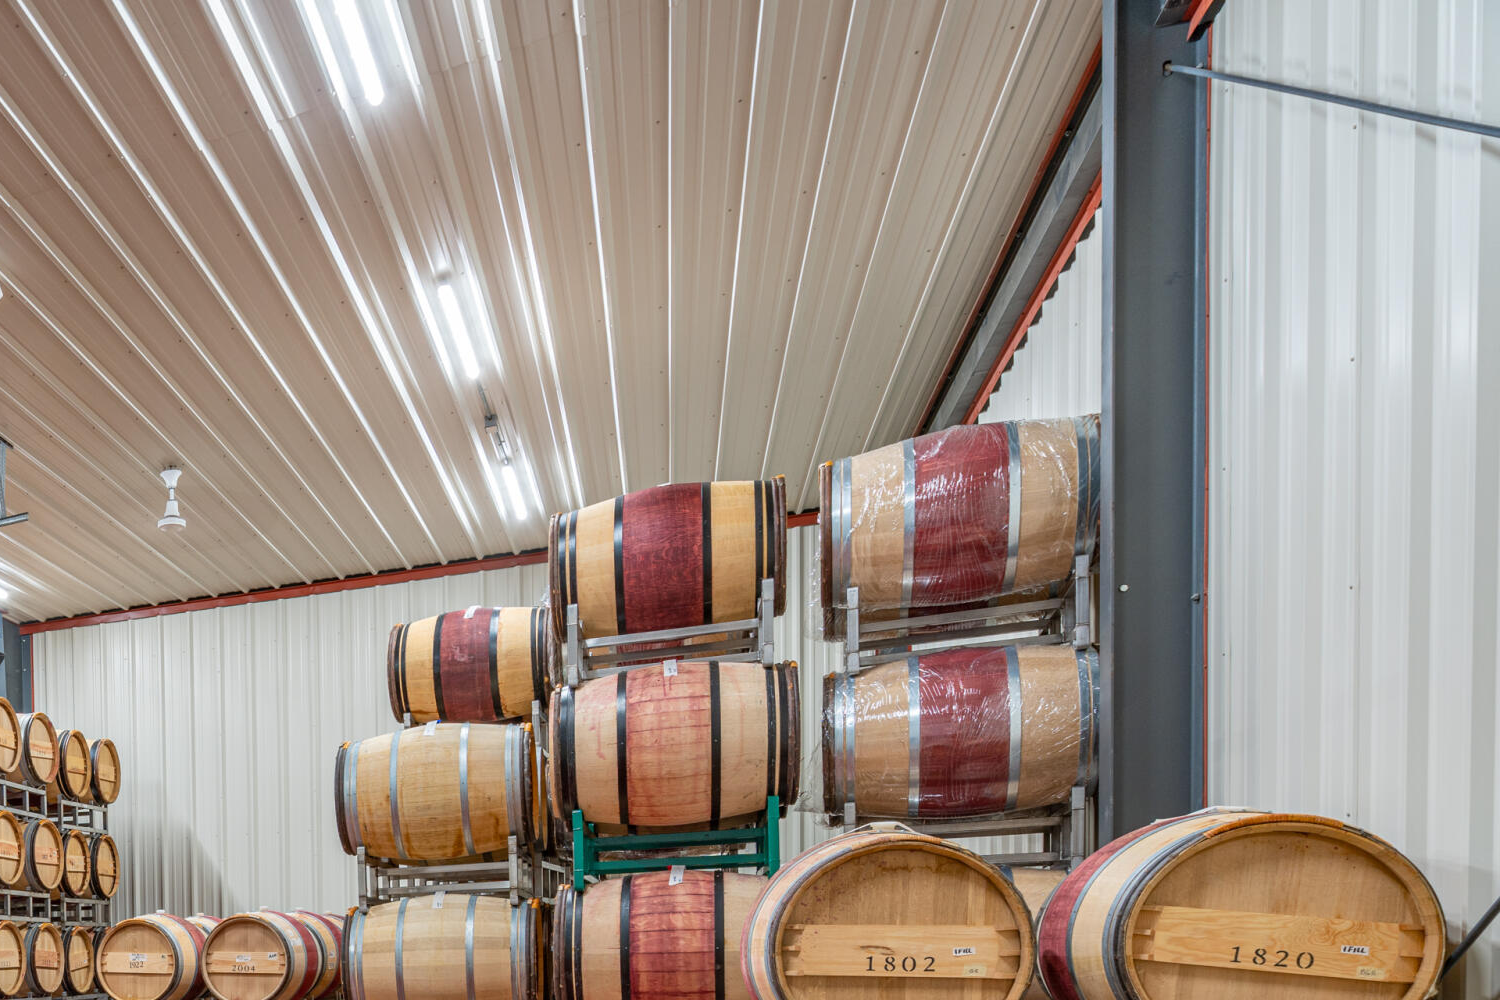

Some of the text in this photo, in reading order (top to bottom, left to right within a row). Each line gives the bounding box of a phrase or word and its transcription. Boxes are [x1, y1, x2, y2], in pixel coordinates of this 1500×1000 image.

[129, 961, 144, 969] 1922
[865, 956, 936, 972] 1802
[1229, 946, 1315, 969] 1820
